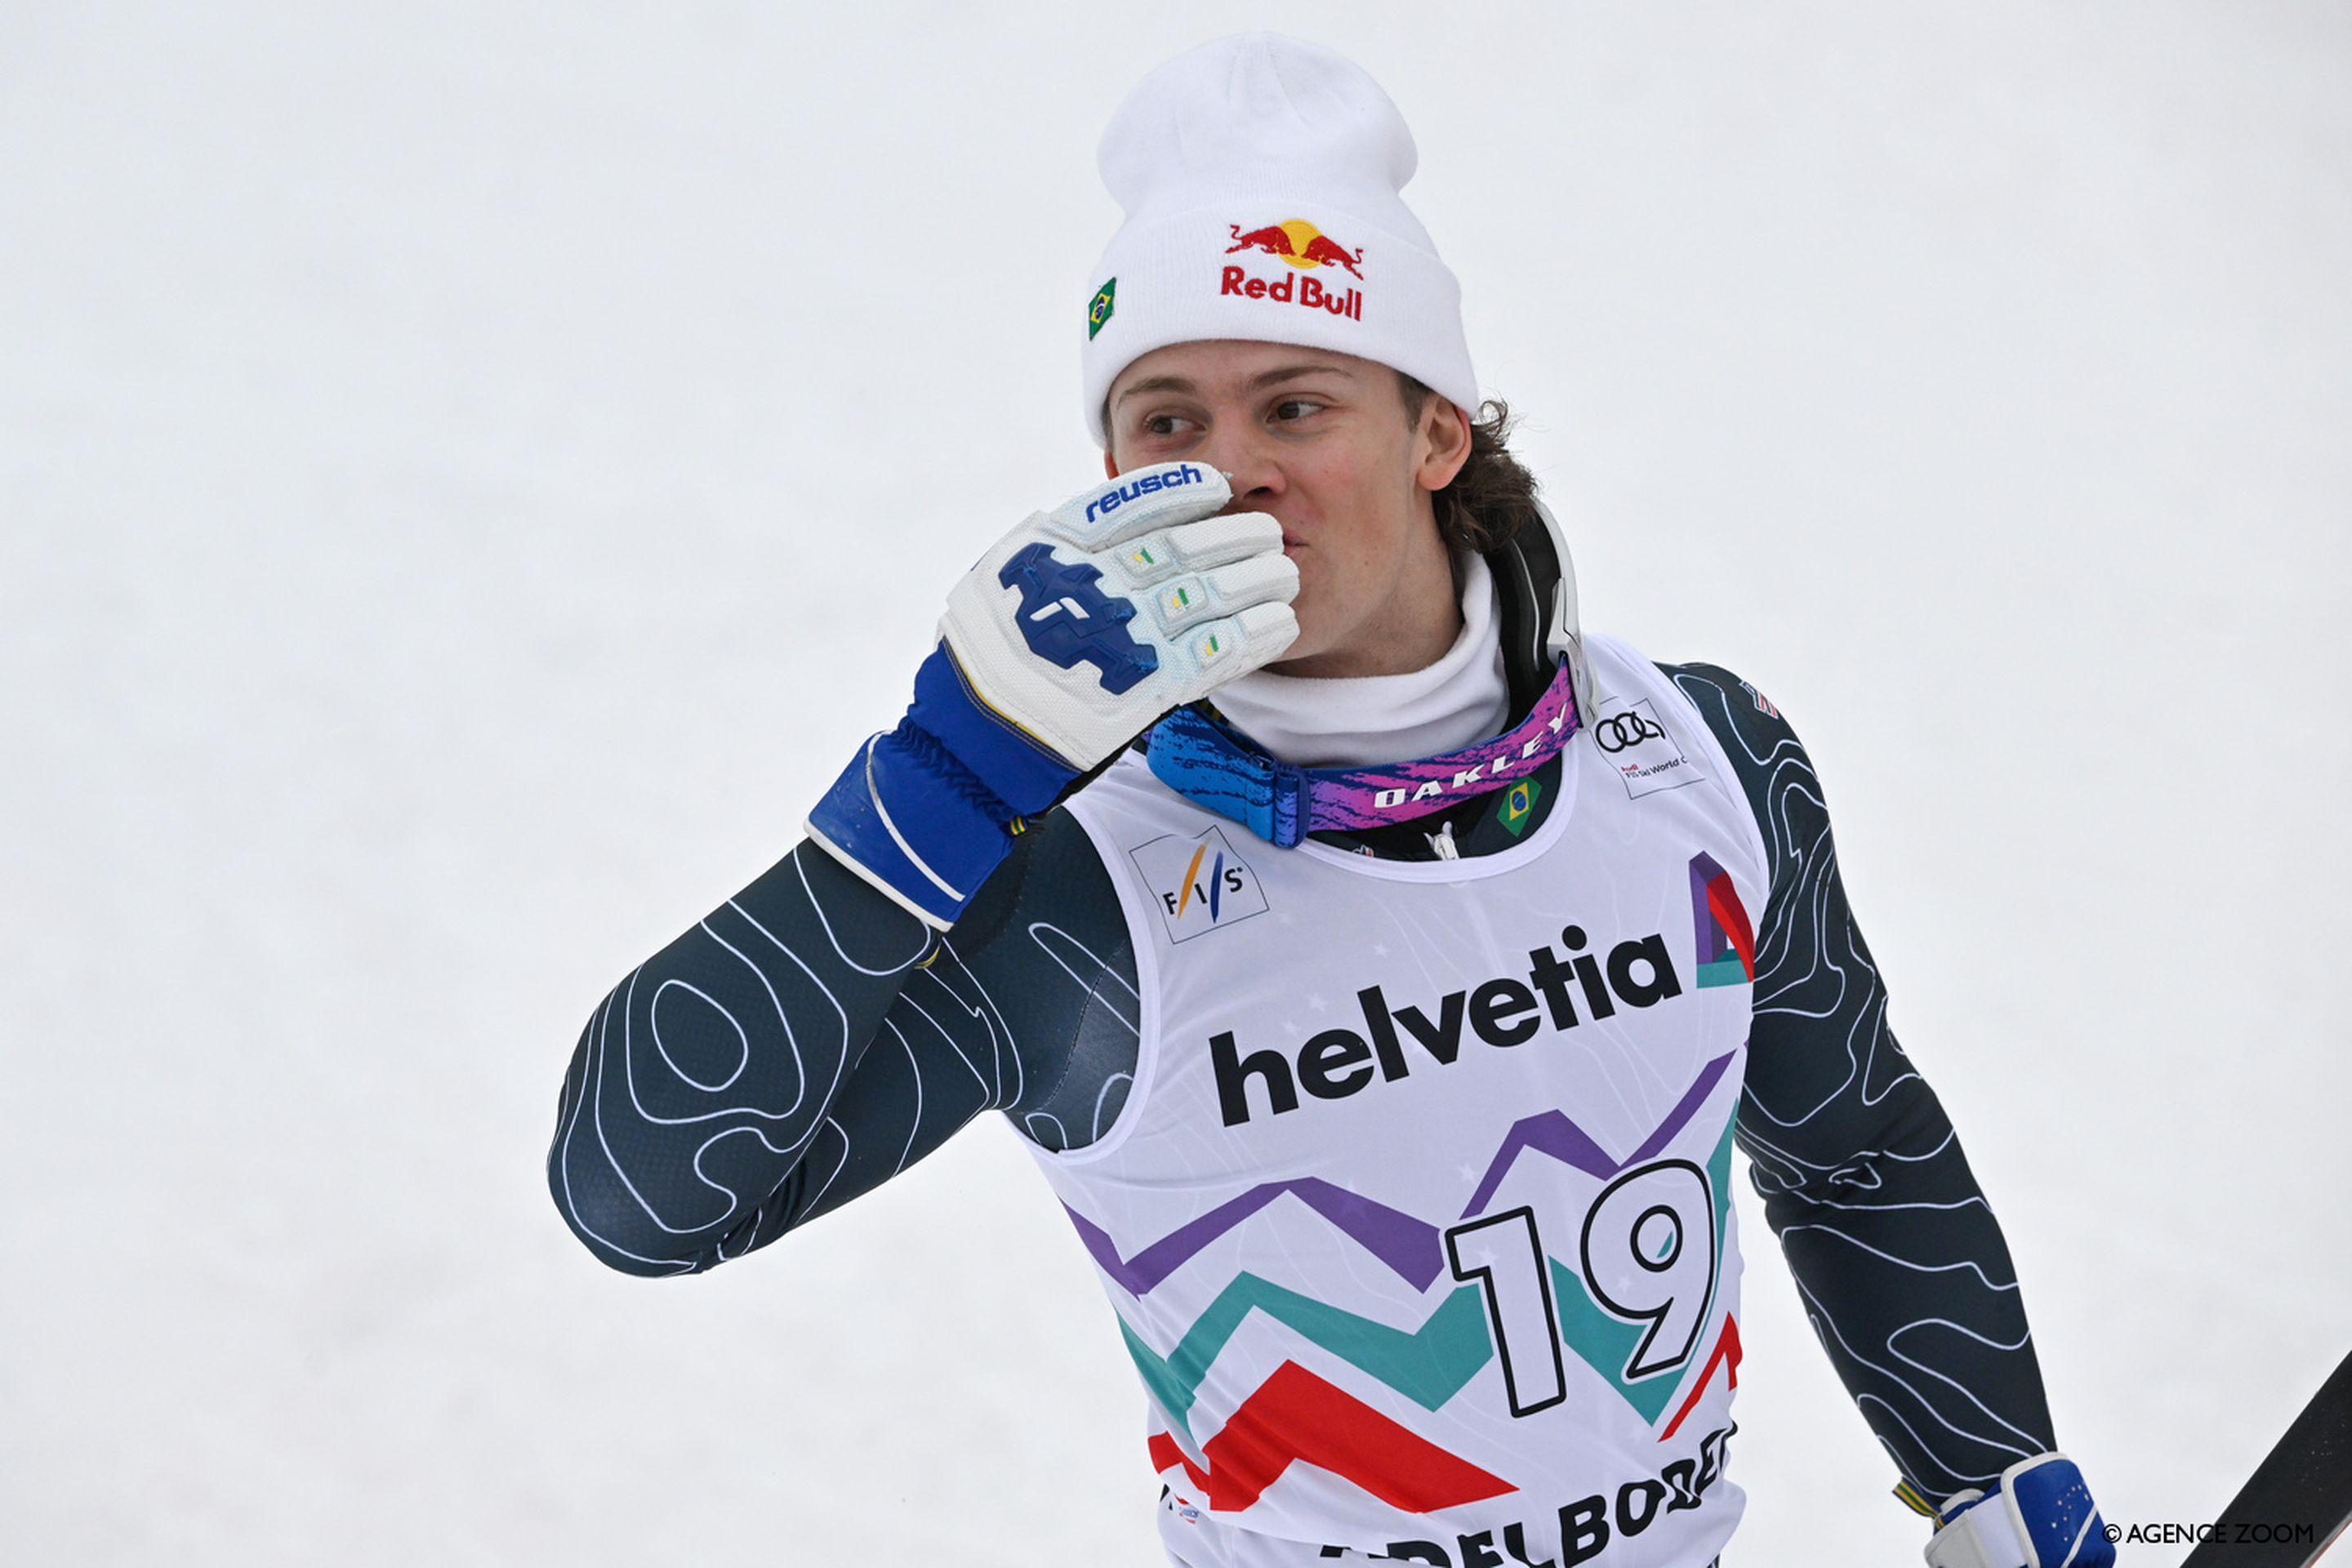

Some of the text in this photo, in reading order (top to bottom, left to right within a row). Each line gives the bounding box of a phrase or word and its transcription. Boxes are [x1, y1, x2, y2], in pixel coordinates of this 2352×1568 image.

[1221, 265, 1362, 322] Red Bull
[1085, 464, 1202, 523] reusch
[1374, 702, 1567, 808] OAKLEY
[1649, 759, 1679, 774] World
[1162, 866, 1243, 915] FIS
[1209, 924, 1682, 1127] helvetia
[1445, 1158, 1715, 1418] 19
